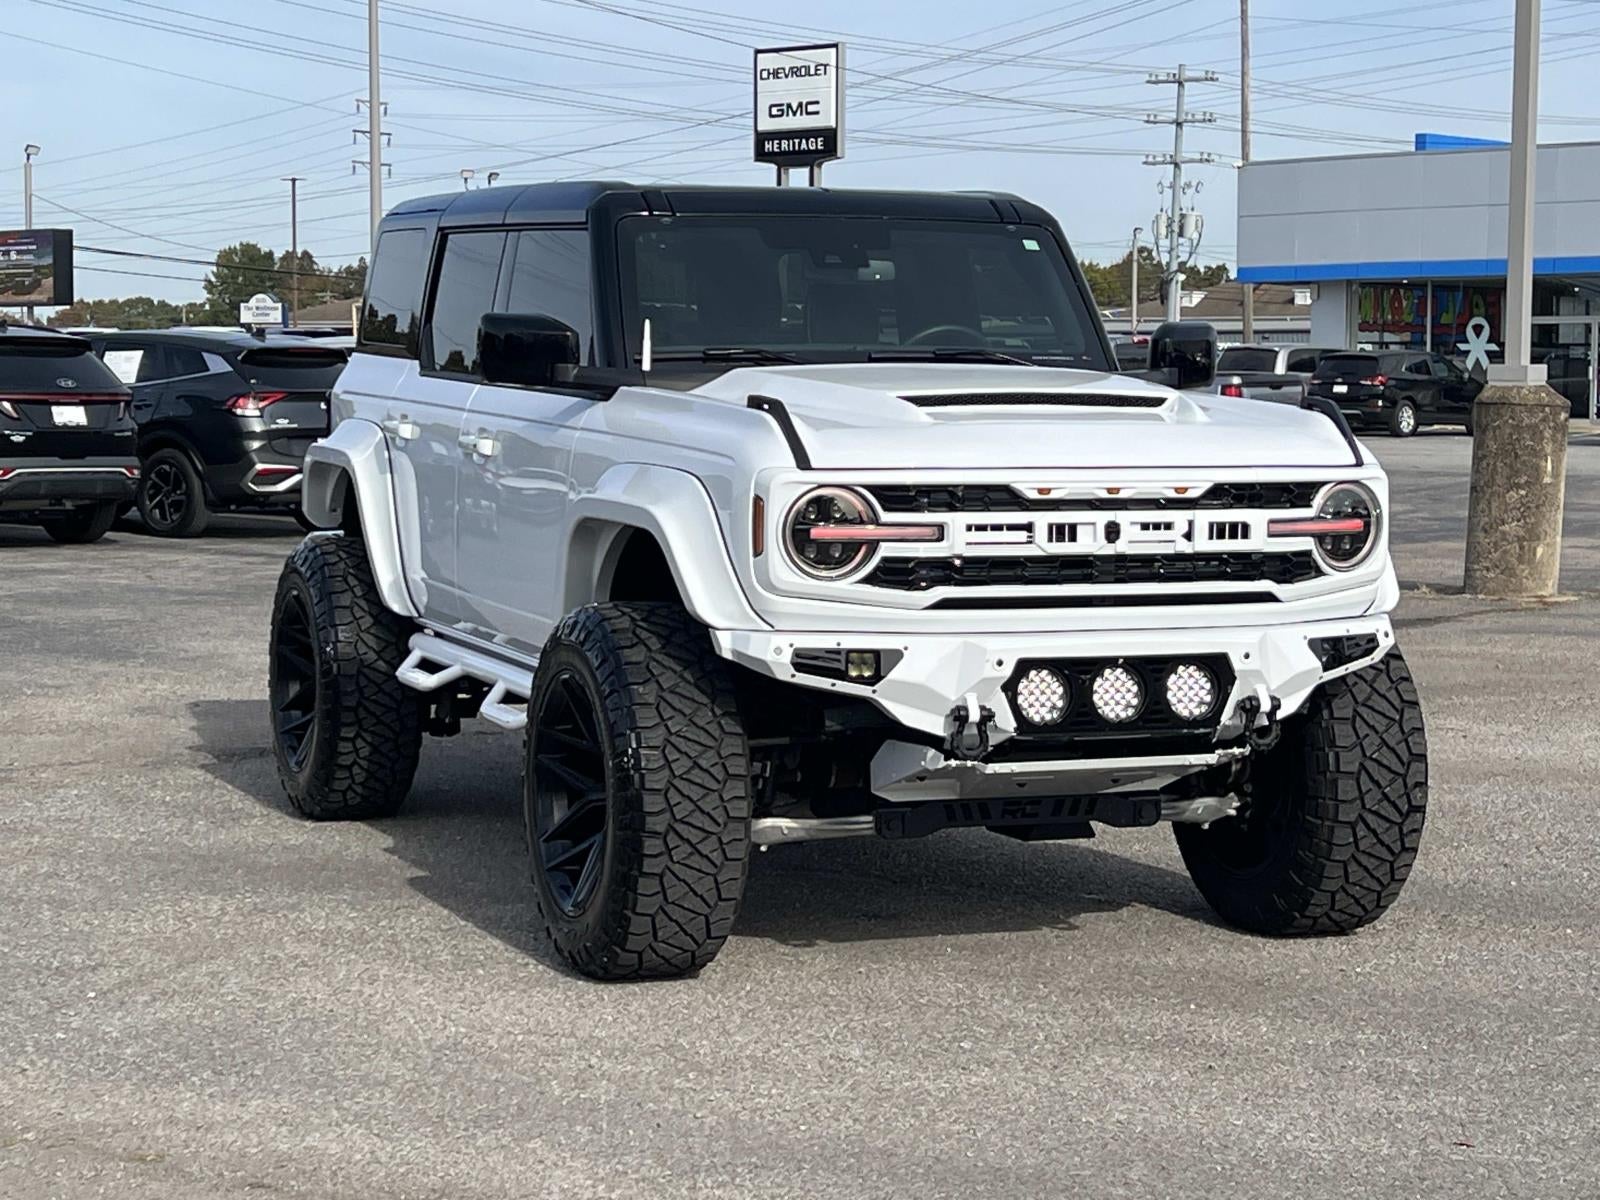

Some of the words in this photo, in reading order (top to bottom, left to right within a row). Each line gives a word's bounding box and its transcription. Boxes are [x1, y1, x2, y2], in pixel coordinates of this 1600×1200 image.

[760, 63, 829, 80] CHEVROLET
[768, 100, 820, 118] GMC
[764, 137, 824, 152] HERITAGE
